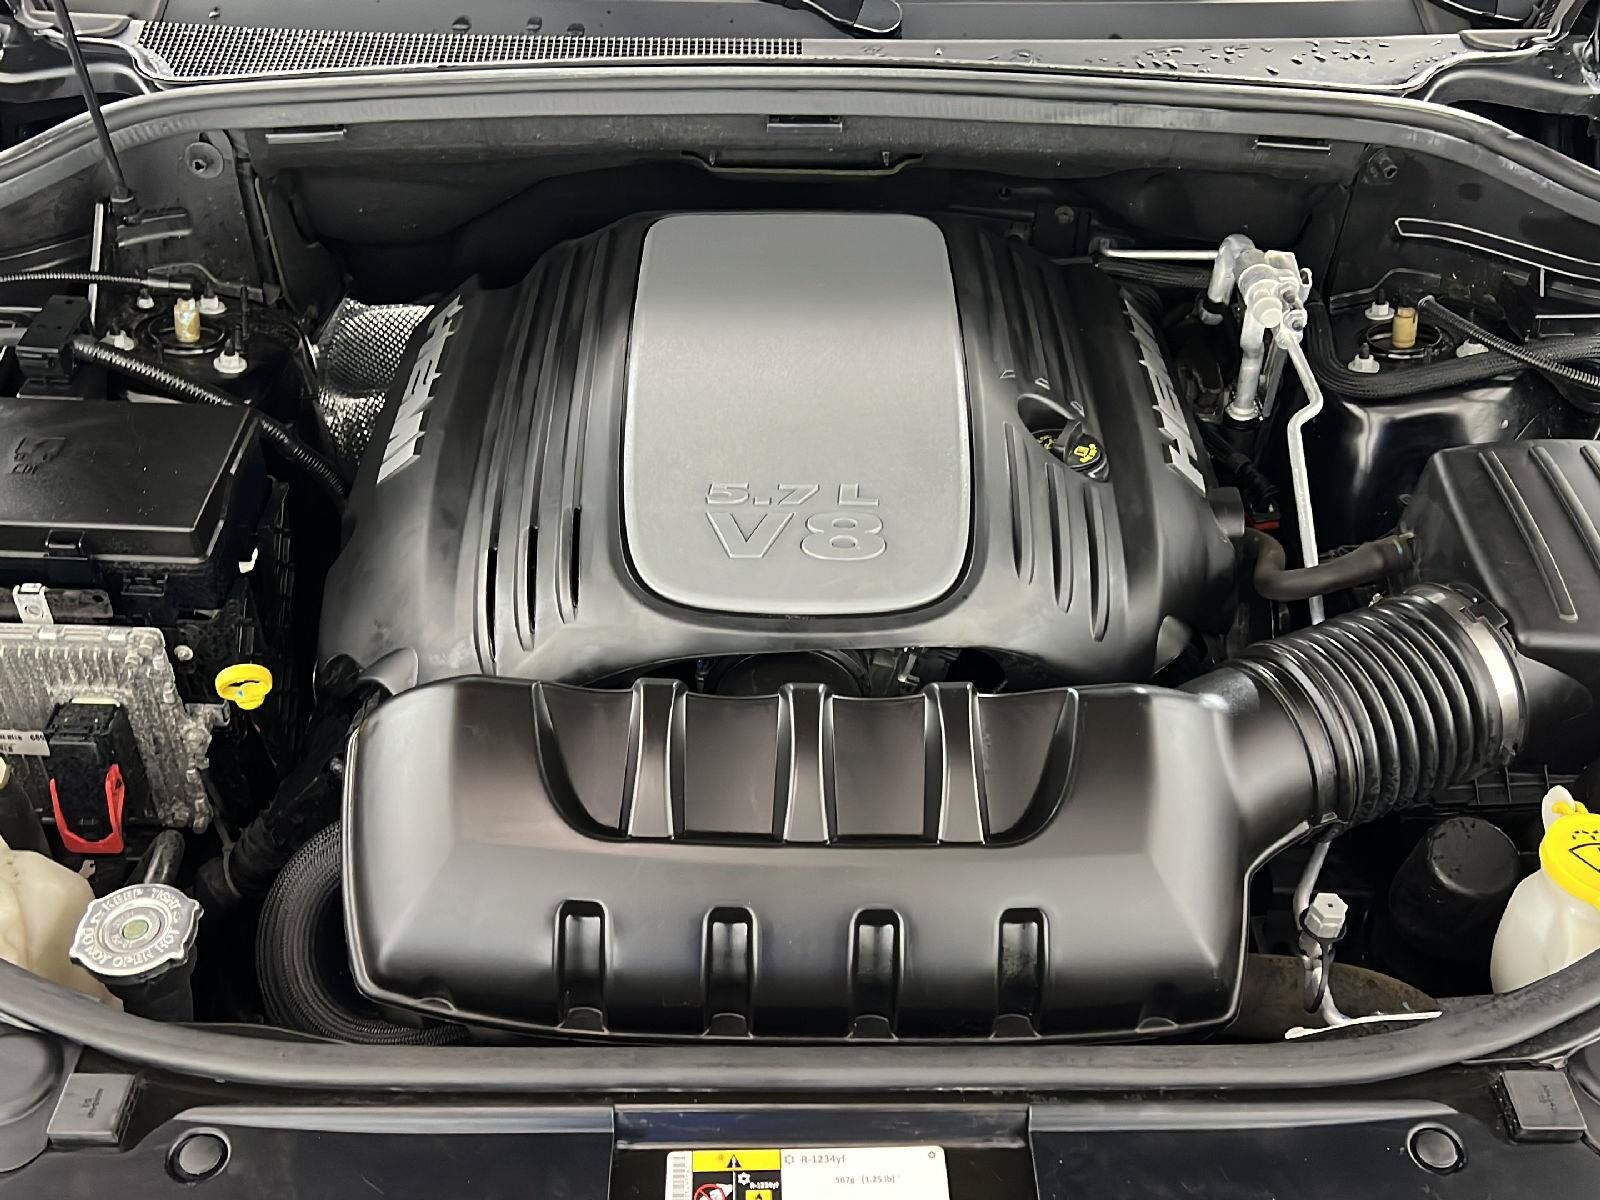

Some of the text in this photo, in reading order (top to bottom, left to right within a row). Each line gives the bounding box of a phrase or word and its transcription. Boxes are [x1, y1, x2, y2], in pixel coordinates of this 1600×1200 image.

[377, 294, 464, 485] HEMI
[705, 482, 879, 506] 5.7 L
[705, 510, 887, 561] V8
[801, 1153, 846, 1165] R-1234yf
